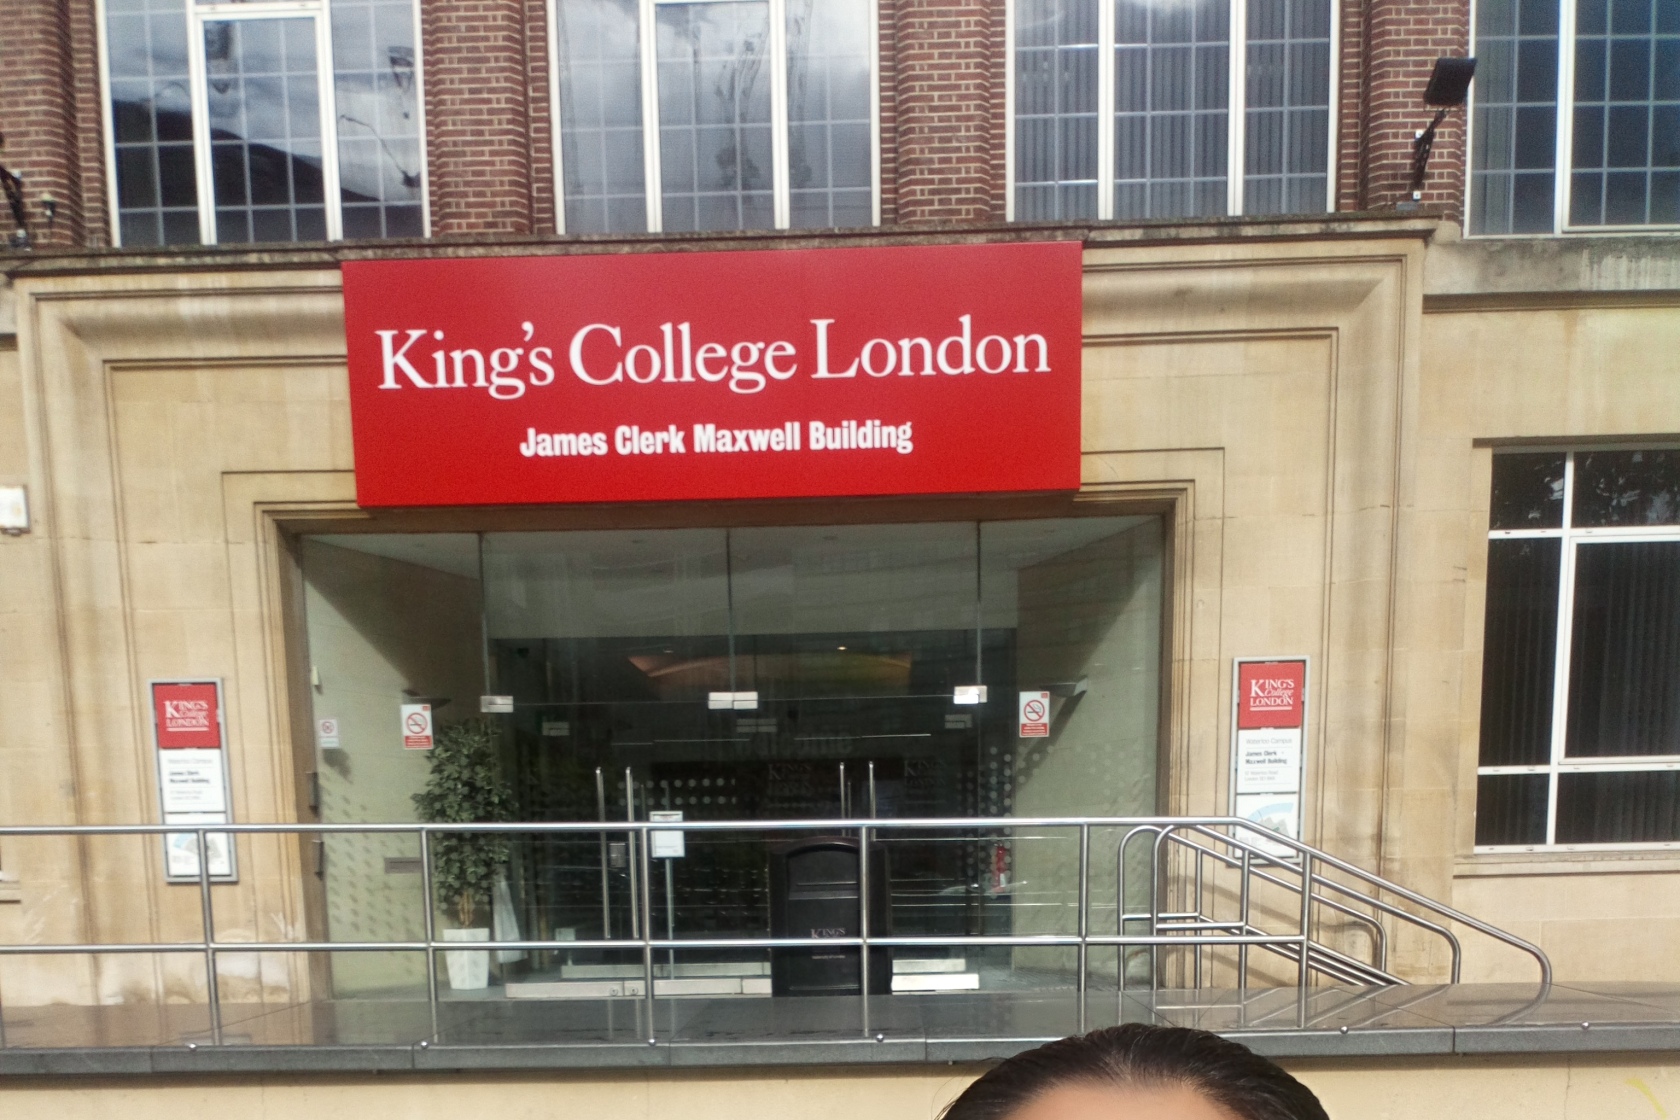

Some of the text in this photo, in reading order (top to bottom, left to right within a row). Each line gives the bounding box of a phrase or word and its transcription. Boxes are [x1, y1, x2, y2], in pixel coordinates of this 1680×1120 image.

[374, 313, 1052, 400] King's College London
[519, 419, 914, 457] James Clerk Maxwell Building
[1249, 697, 1294, 706] LONDON
